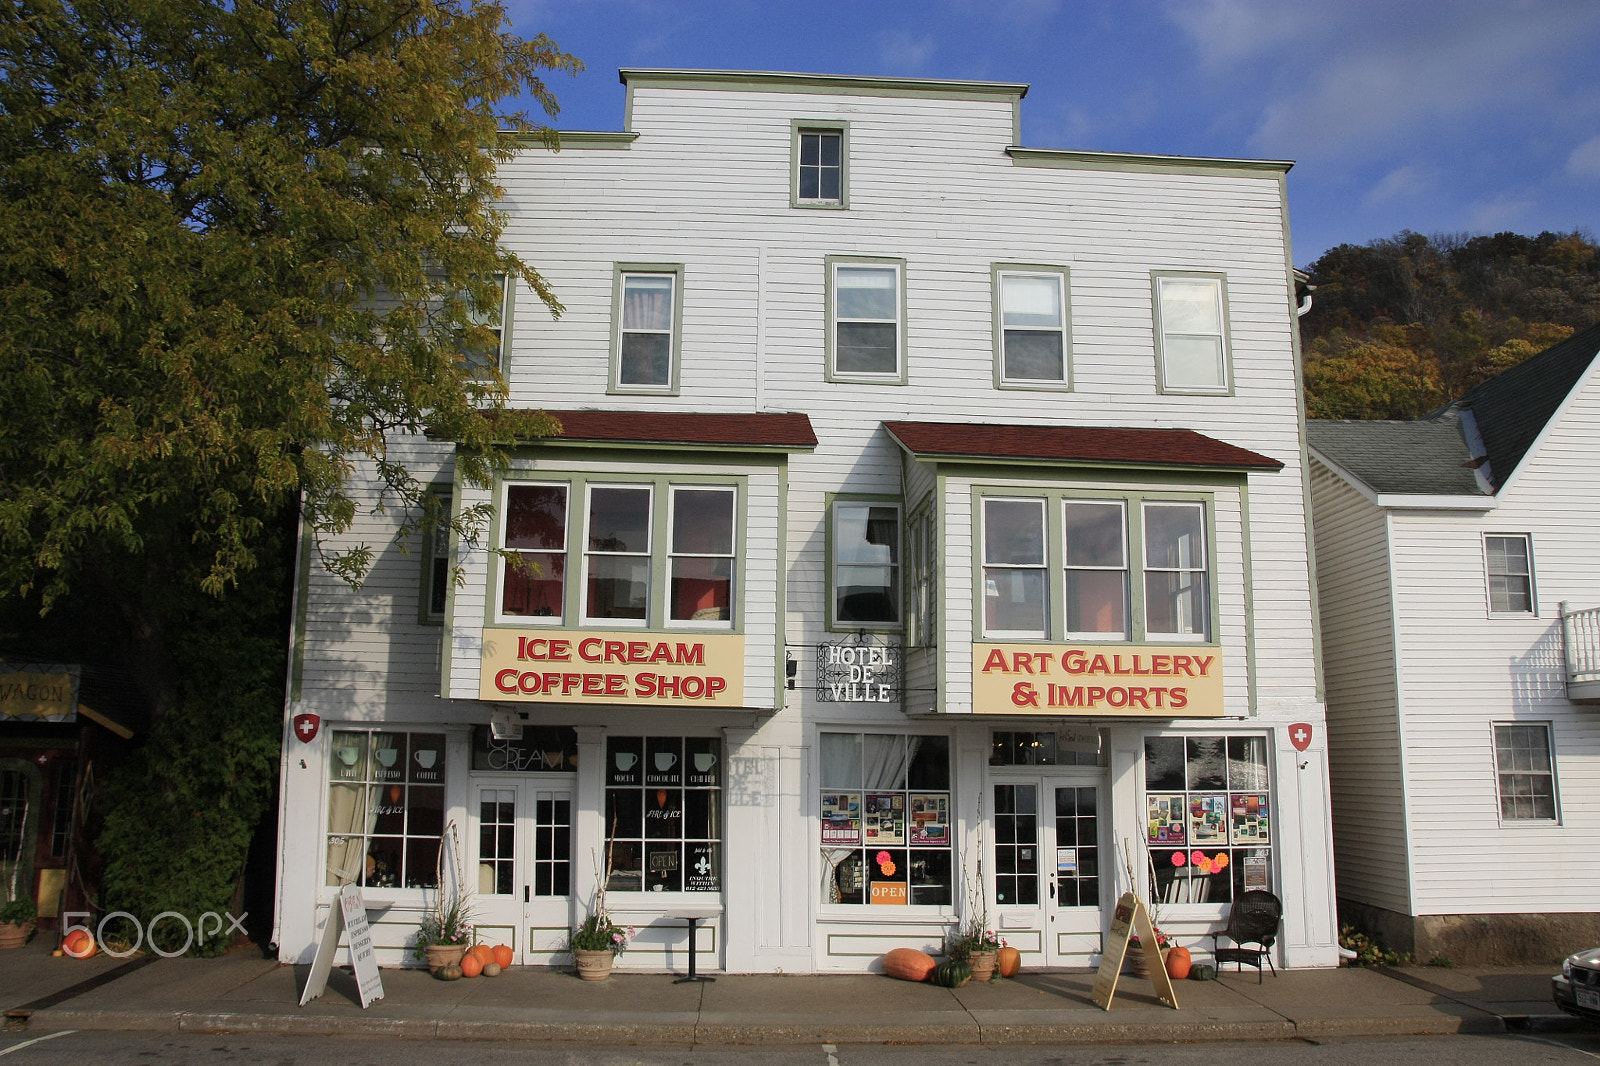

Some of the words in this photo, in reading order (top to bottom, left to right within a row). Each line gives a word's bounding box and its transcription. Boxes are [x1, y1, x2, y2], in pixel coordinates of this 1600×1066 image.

[517, 636, 572, 661] ICE
[577, 637, 706, 666] CREAM
[828, 646, 893, 665] HOTEL
[981, 648, 1054, 675] ART
[1061, 649, 1217, 678] GALLERY
[494, 668, 628, 696] COFFEE
[634, 672, 727, 699] SHOP
[849, 665, 875, 684] DE
[830, 683, 891, 702] VILLE
[1010, 681, 1041, 709] &
[1047, 682, 1189, 710] IMPORTS
[488, 747, 564, 770] CREAM
[416, 772, 437, 780] COFFEE
[392, 806, 404, 814] ICE
[646, 809, 663, 818] FIRE
[669, 810, 681, 818] ICE
[328, 836, 345, 845] 305
[651, 855, 675, 867] OPEN
[871, 887, 906, 897] OPEN
